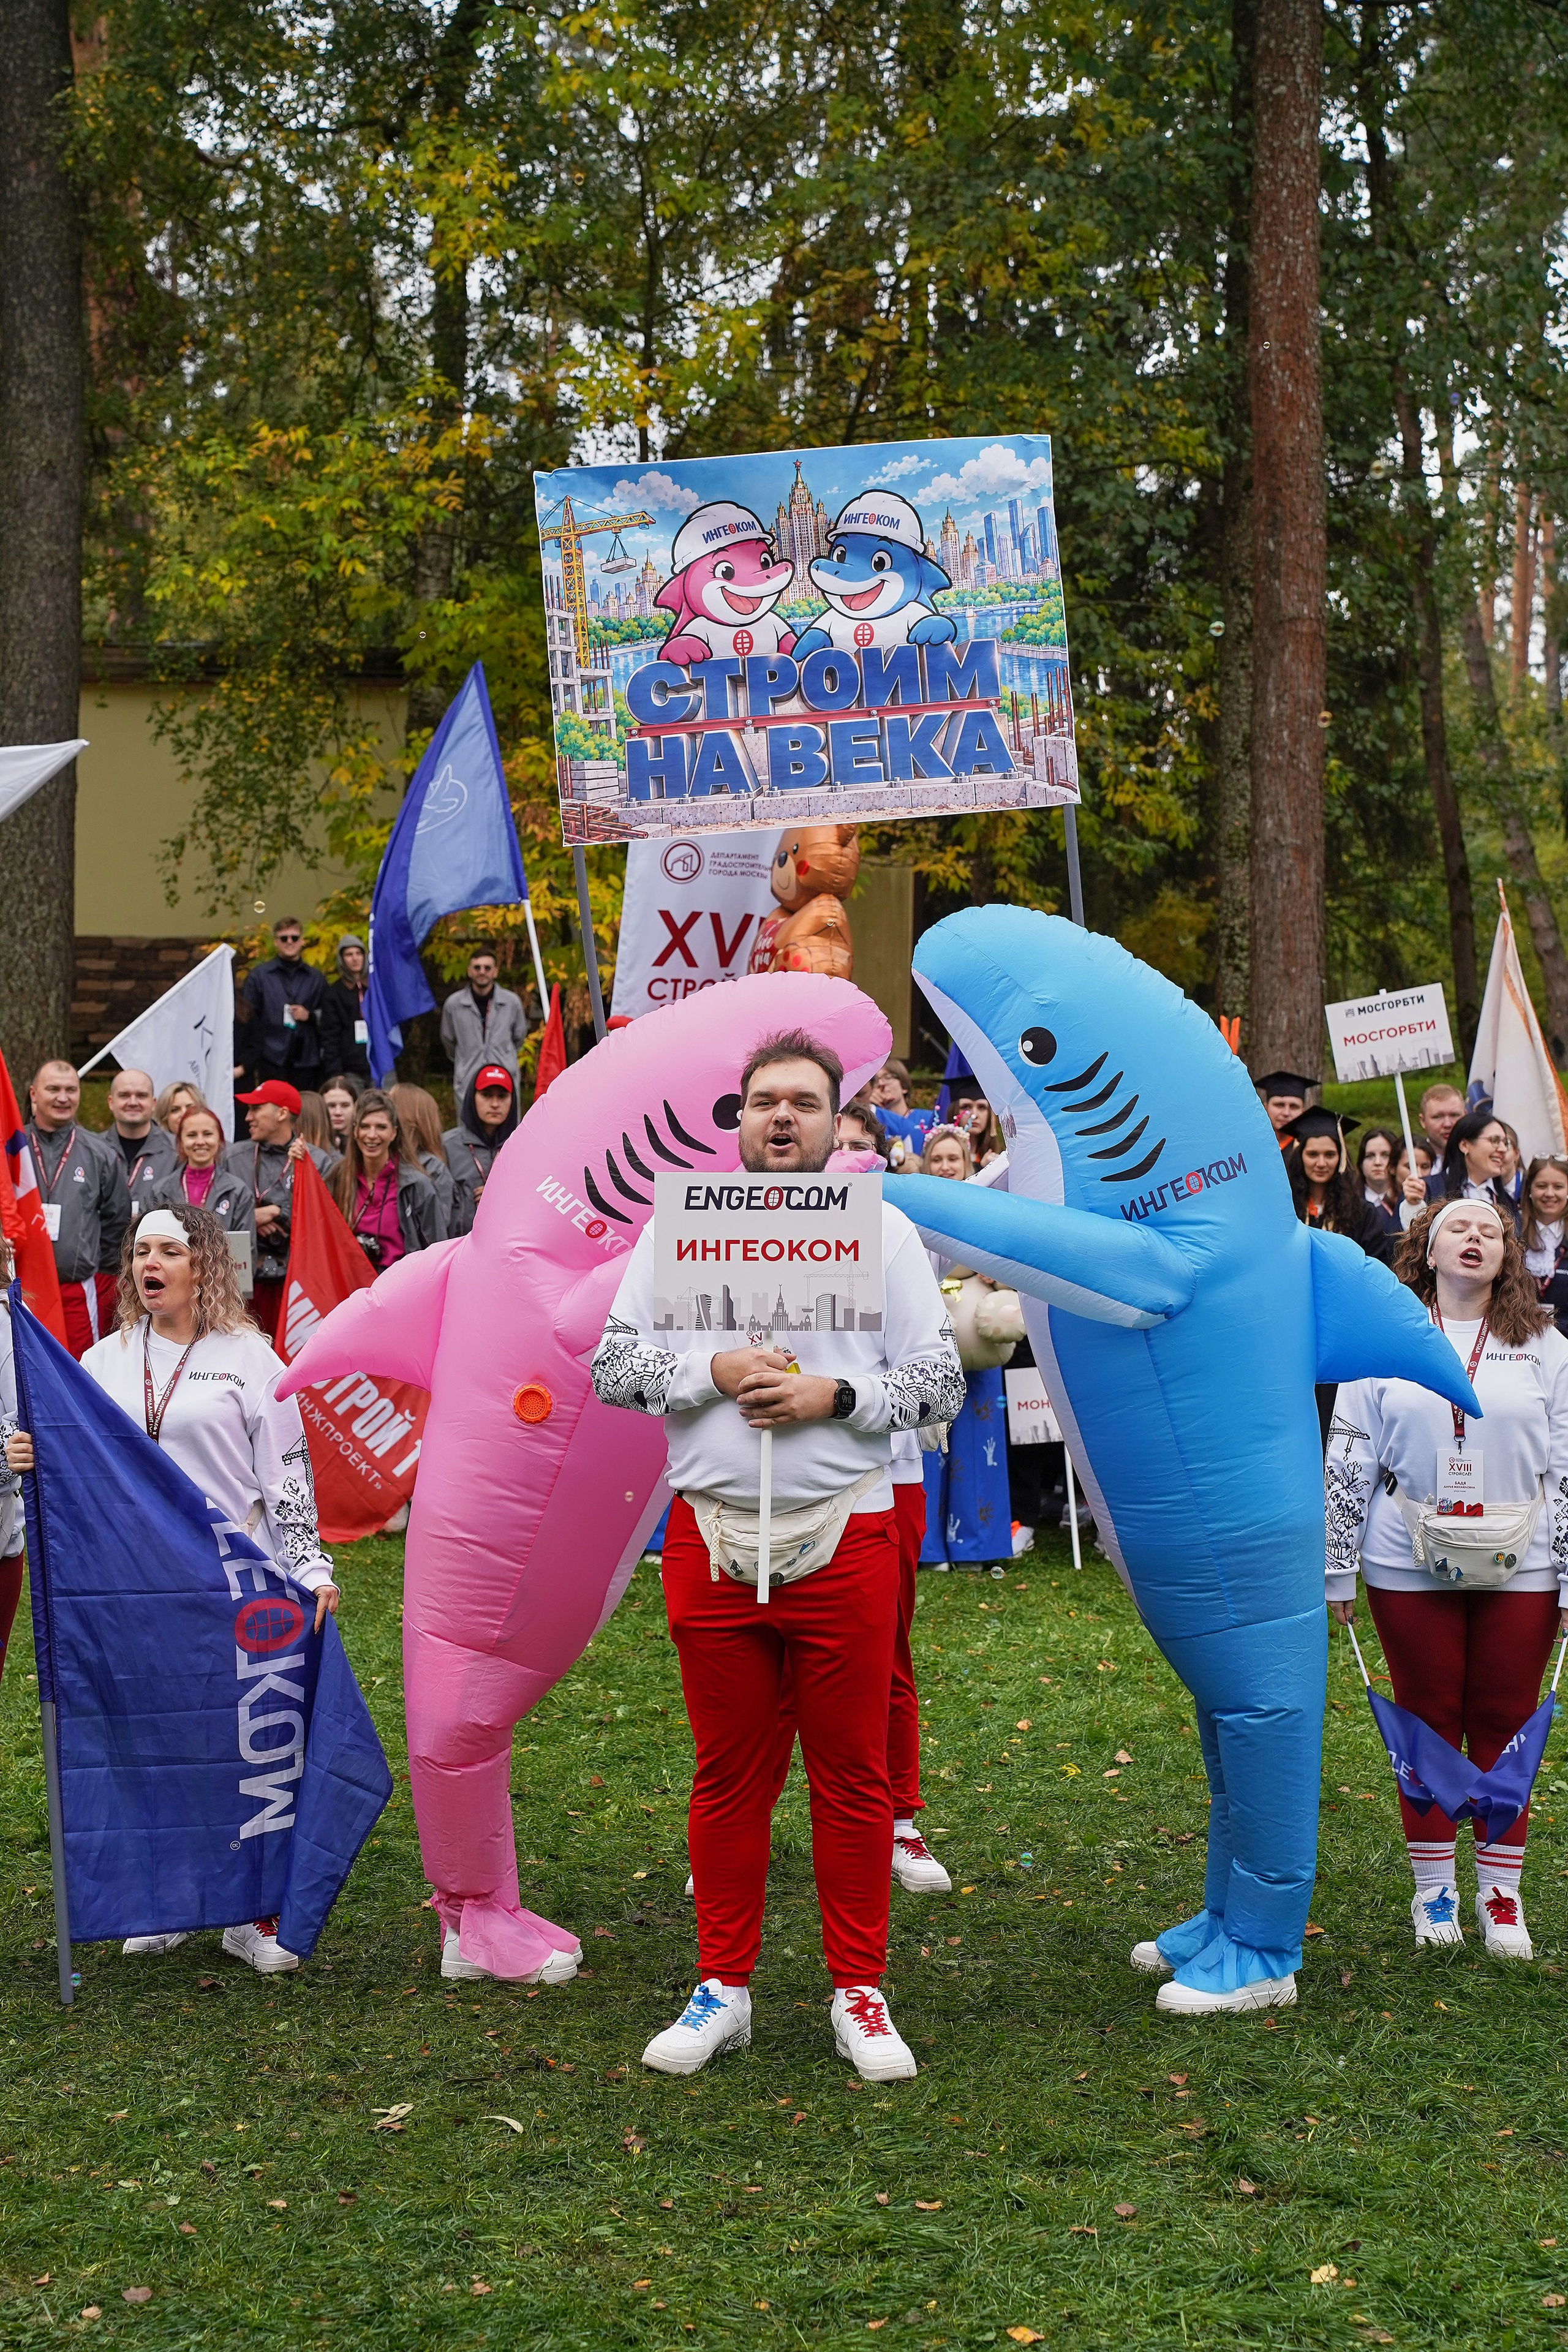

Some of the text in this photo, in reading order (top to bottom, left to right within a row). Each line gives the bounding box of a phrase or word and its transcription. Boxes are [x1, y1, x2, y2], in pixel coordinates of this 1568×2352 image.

[702, 521, 756, 544] ИНГЕОКОМ
[843, 513, 900, 530] ИНГЕОКОМ
[625, 639, 1002, 725] СТРОИМ
[625, 709, 1017, 801] НА ВЕКА
[740, 870, 767, 880] МОСКВЫ
[652, 910, 767, 968] XV
[1357, 995, 1424, 1015] МОСГОРБТИ
[1343, 1019, 1436, 1046] МОСГОРБТИ
[684, 1186, 849, 1210] ENGEOCOM
[1120, 1152, 1248, 1221] ИНГЕОКОМ
[677, 1239, 859, 1261] ИНГЕОКОМ
[189, 1371, 245, 1390] ИНГЕОКОМ
[311, 1370, 417, 1458] ТРОЙ
[1449, 1463, 1472, 1472] XVIII
